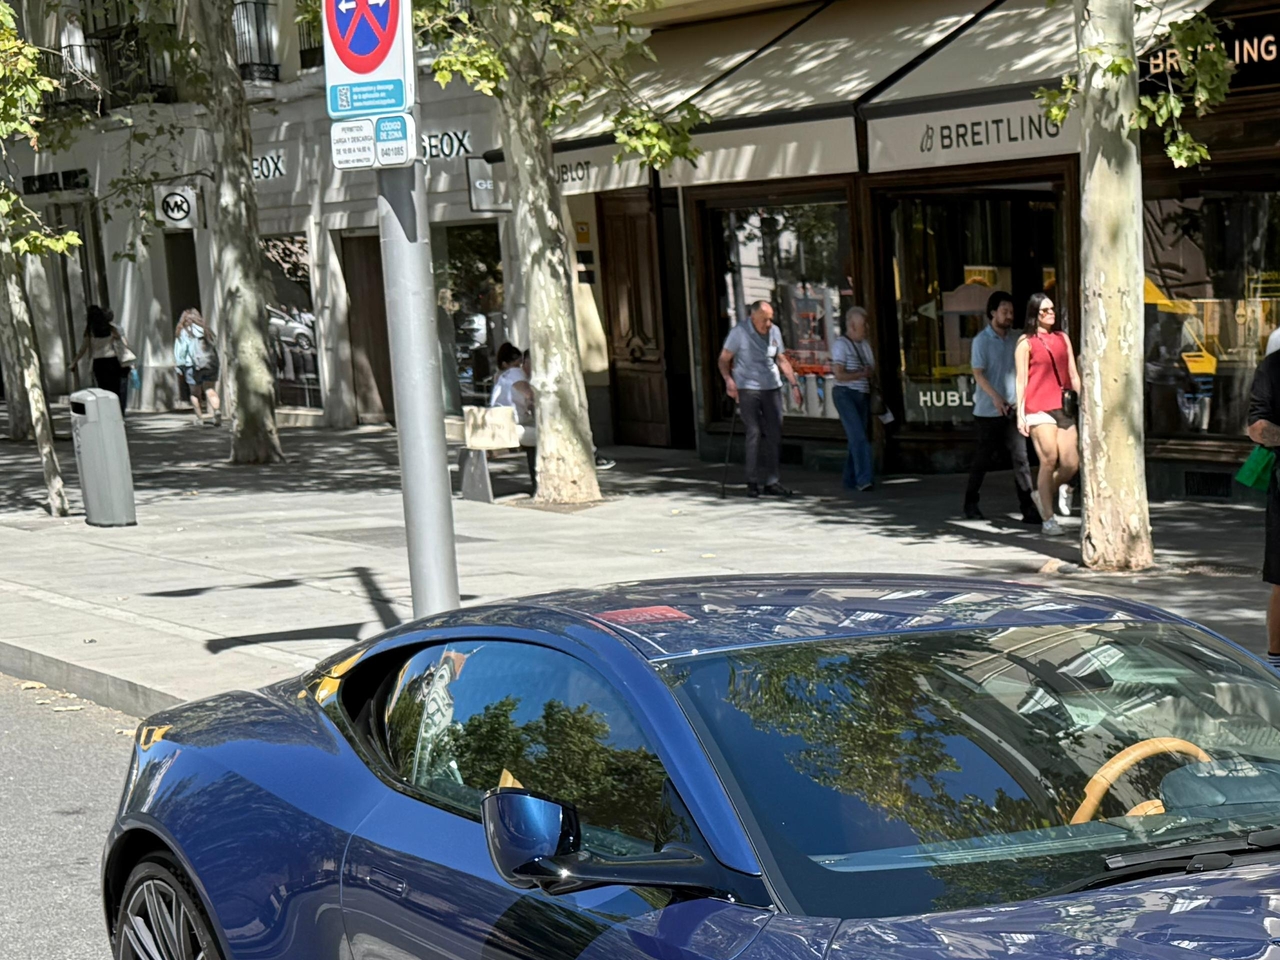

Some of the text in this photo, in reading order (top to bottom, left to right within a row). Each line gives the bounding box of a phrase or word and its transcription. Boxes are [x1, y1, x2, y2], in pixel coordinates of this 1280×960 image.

[1149, 33, 1278, 75] BRING
[940, 113, 1061, 150] BREITLING
[251, 154, 285, 179] EOX
[475, 179, 494, 190] GE
[918, 390, 977, 407] HUBL
